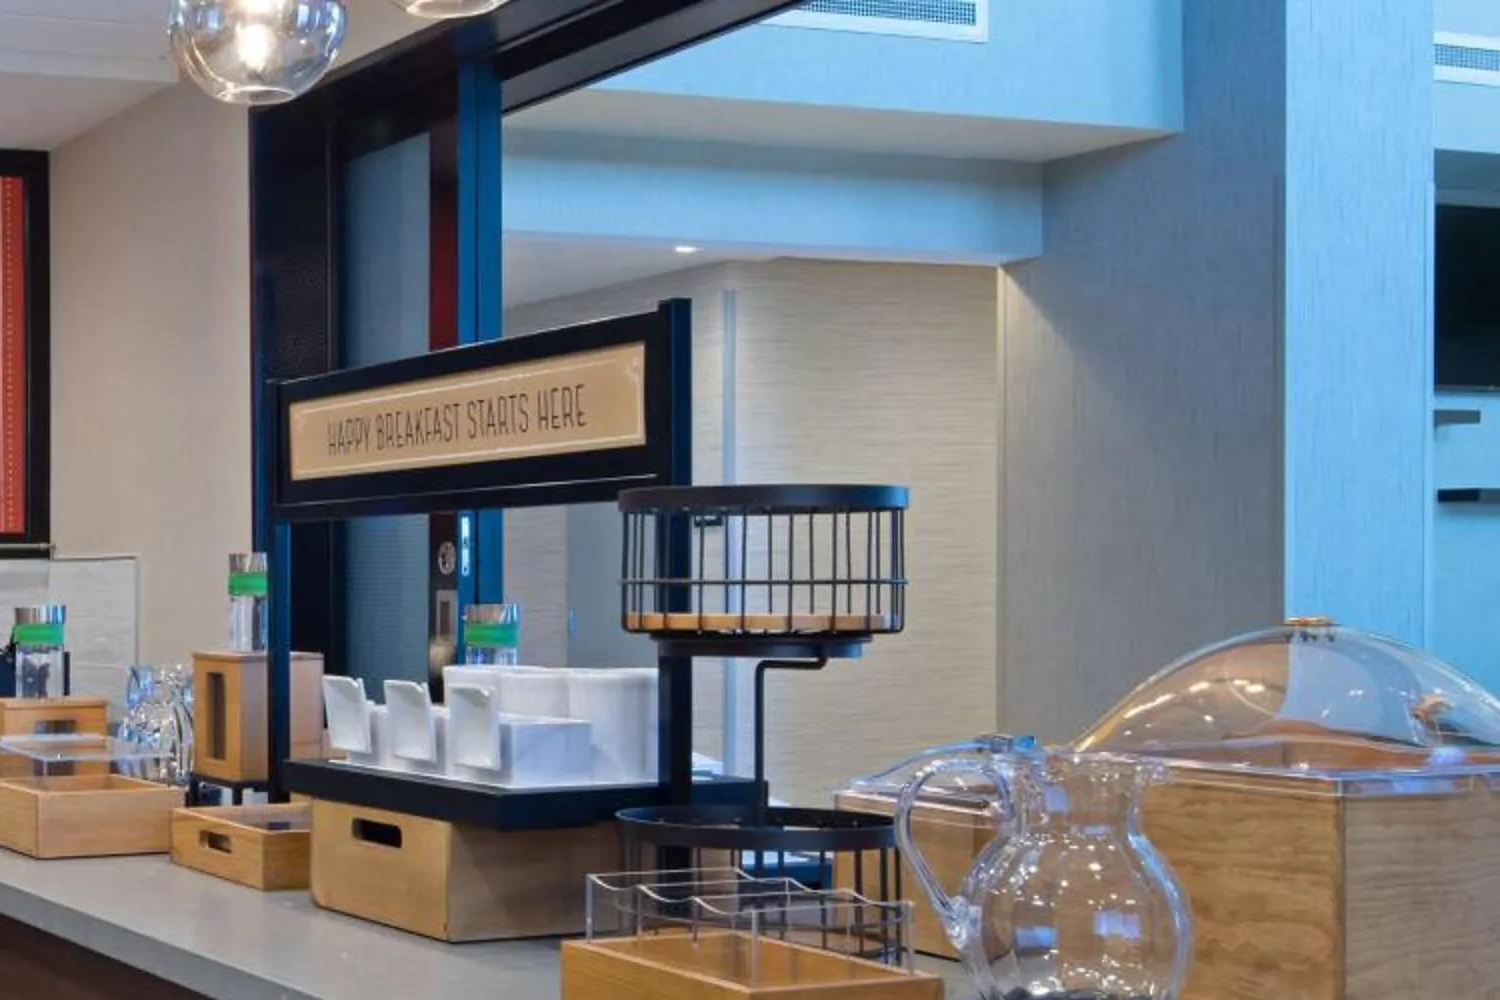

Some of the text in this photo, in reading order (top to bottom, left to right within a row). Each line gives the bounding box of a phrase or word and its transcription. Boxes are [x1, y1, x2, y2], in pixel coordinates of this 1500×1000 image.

[327, 384, 588, 456] HAPPY BREAKFAST STARTS HERE
